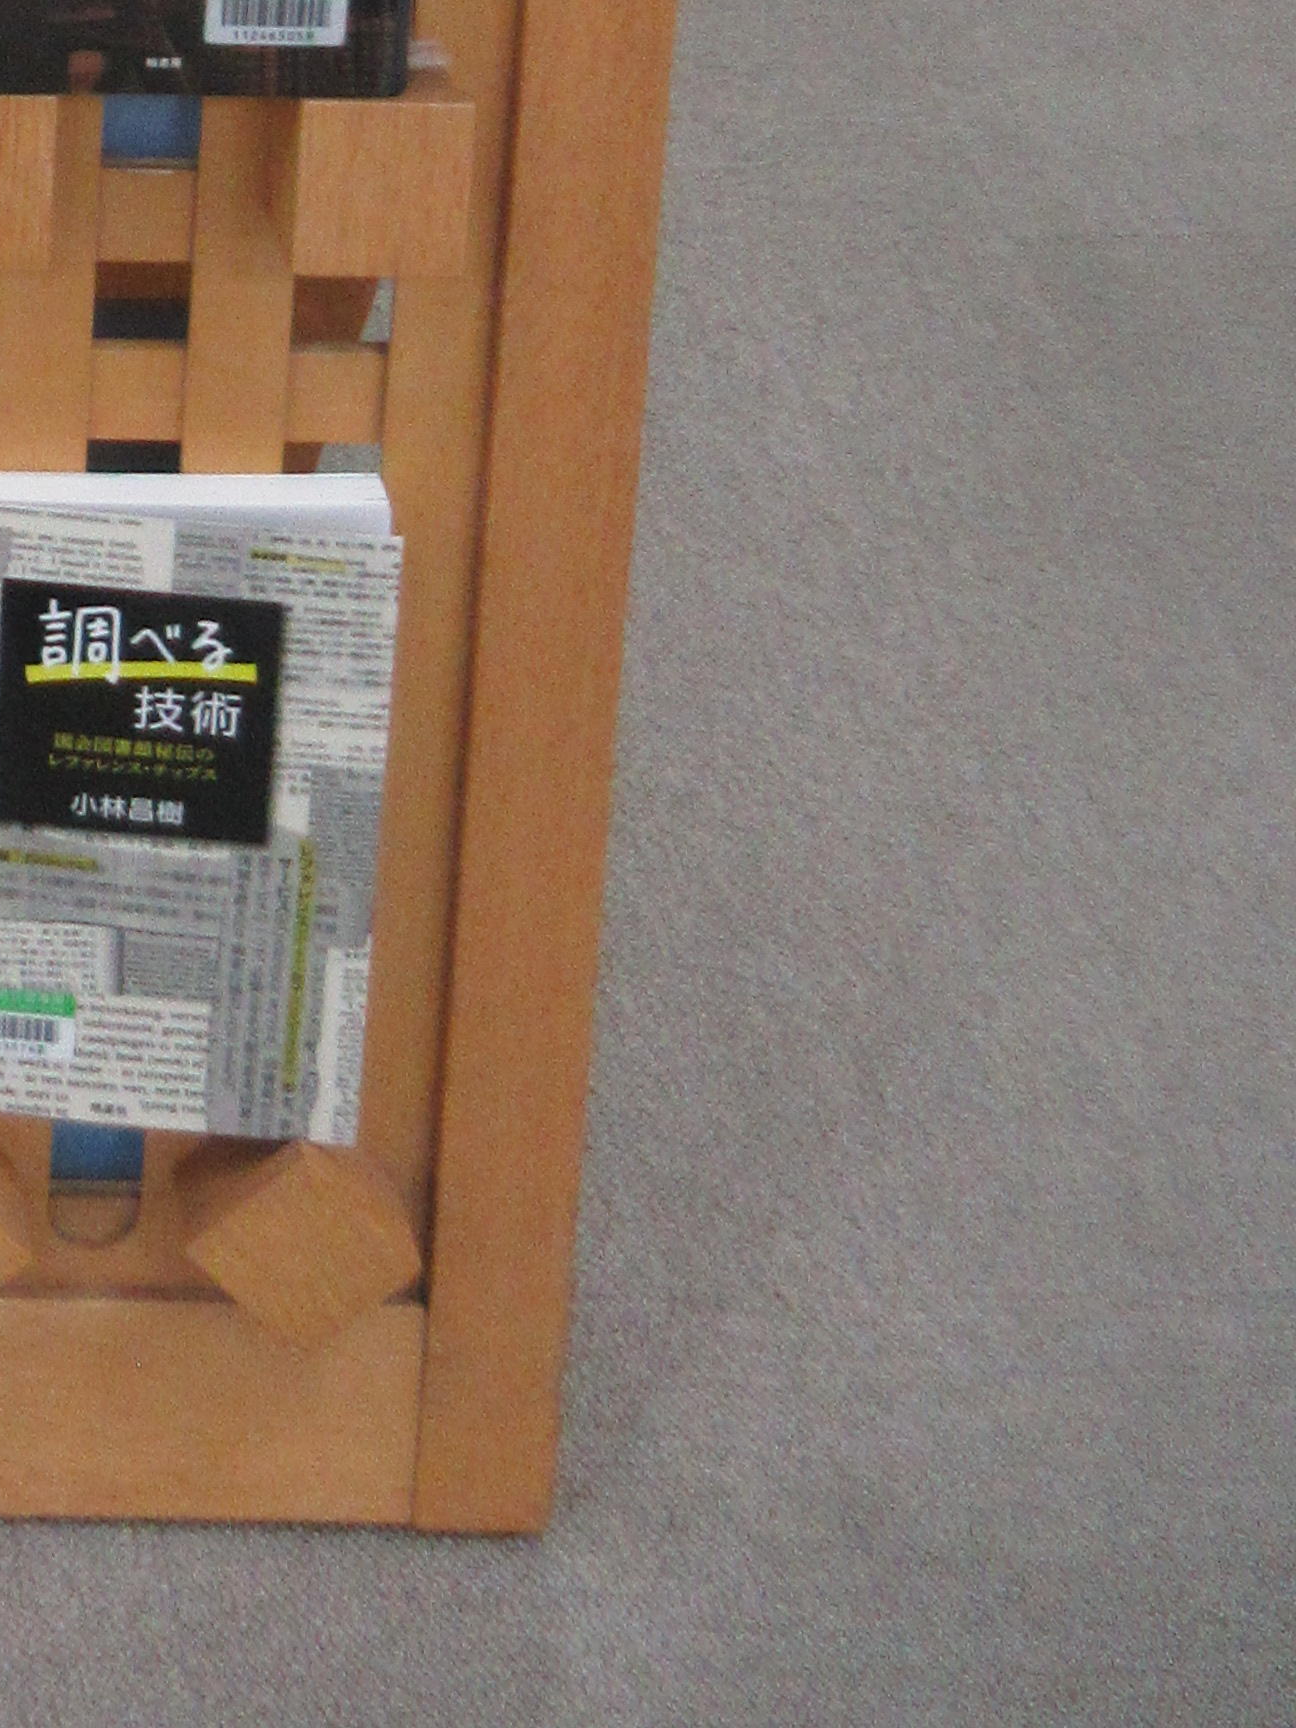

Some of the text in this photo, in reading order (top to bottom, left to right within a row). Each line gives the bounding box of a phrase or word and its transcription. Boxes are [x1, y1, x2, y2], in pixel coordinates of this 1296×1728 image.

[38, 598, 233, 684] 調べる
[134, 686, 242, 738] 技術
